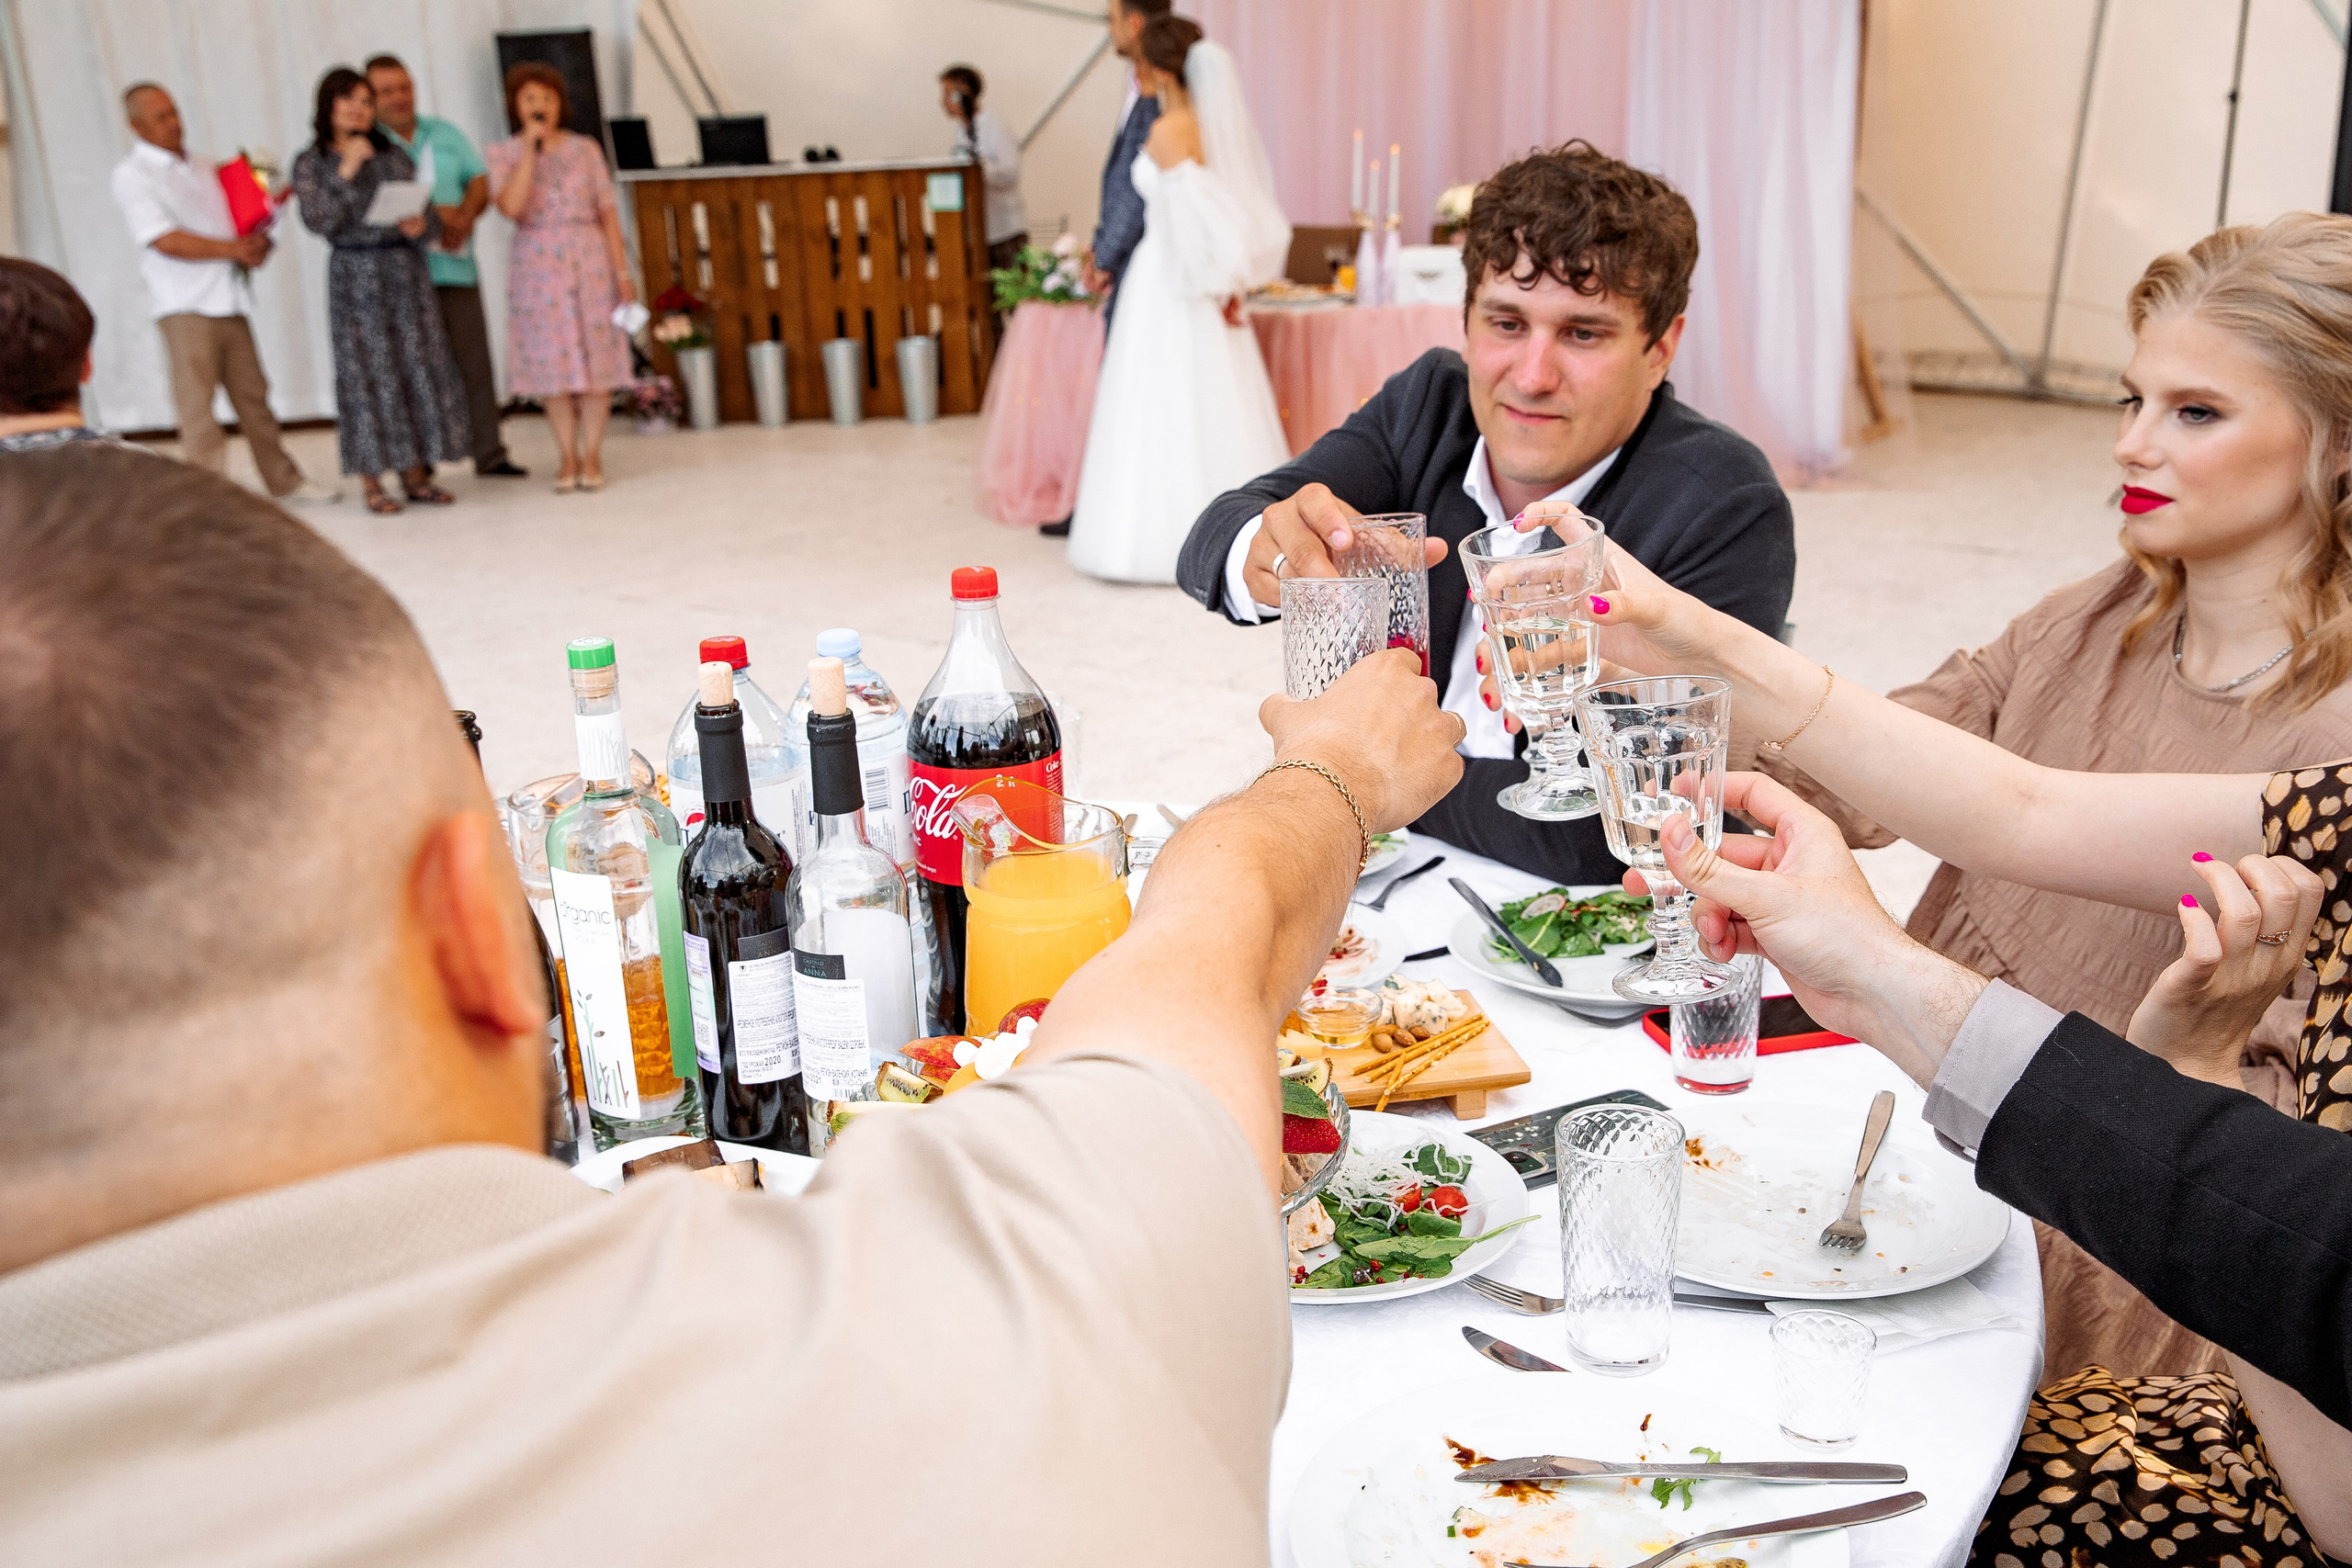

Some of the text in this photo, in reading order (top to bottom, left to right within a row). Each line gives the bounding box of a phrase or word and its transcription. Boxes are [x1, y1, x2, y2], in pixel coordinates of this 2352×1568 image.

[560, 901, 611, 926] organic
[803, 958, 824, 966] CASTILLO
[803, 967, 827, 978] ANNA
